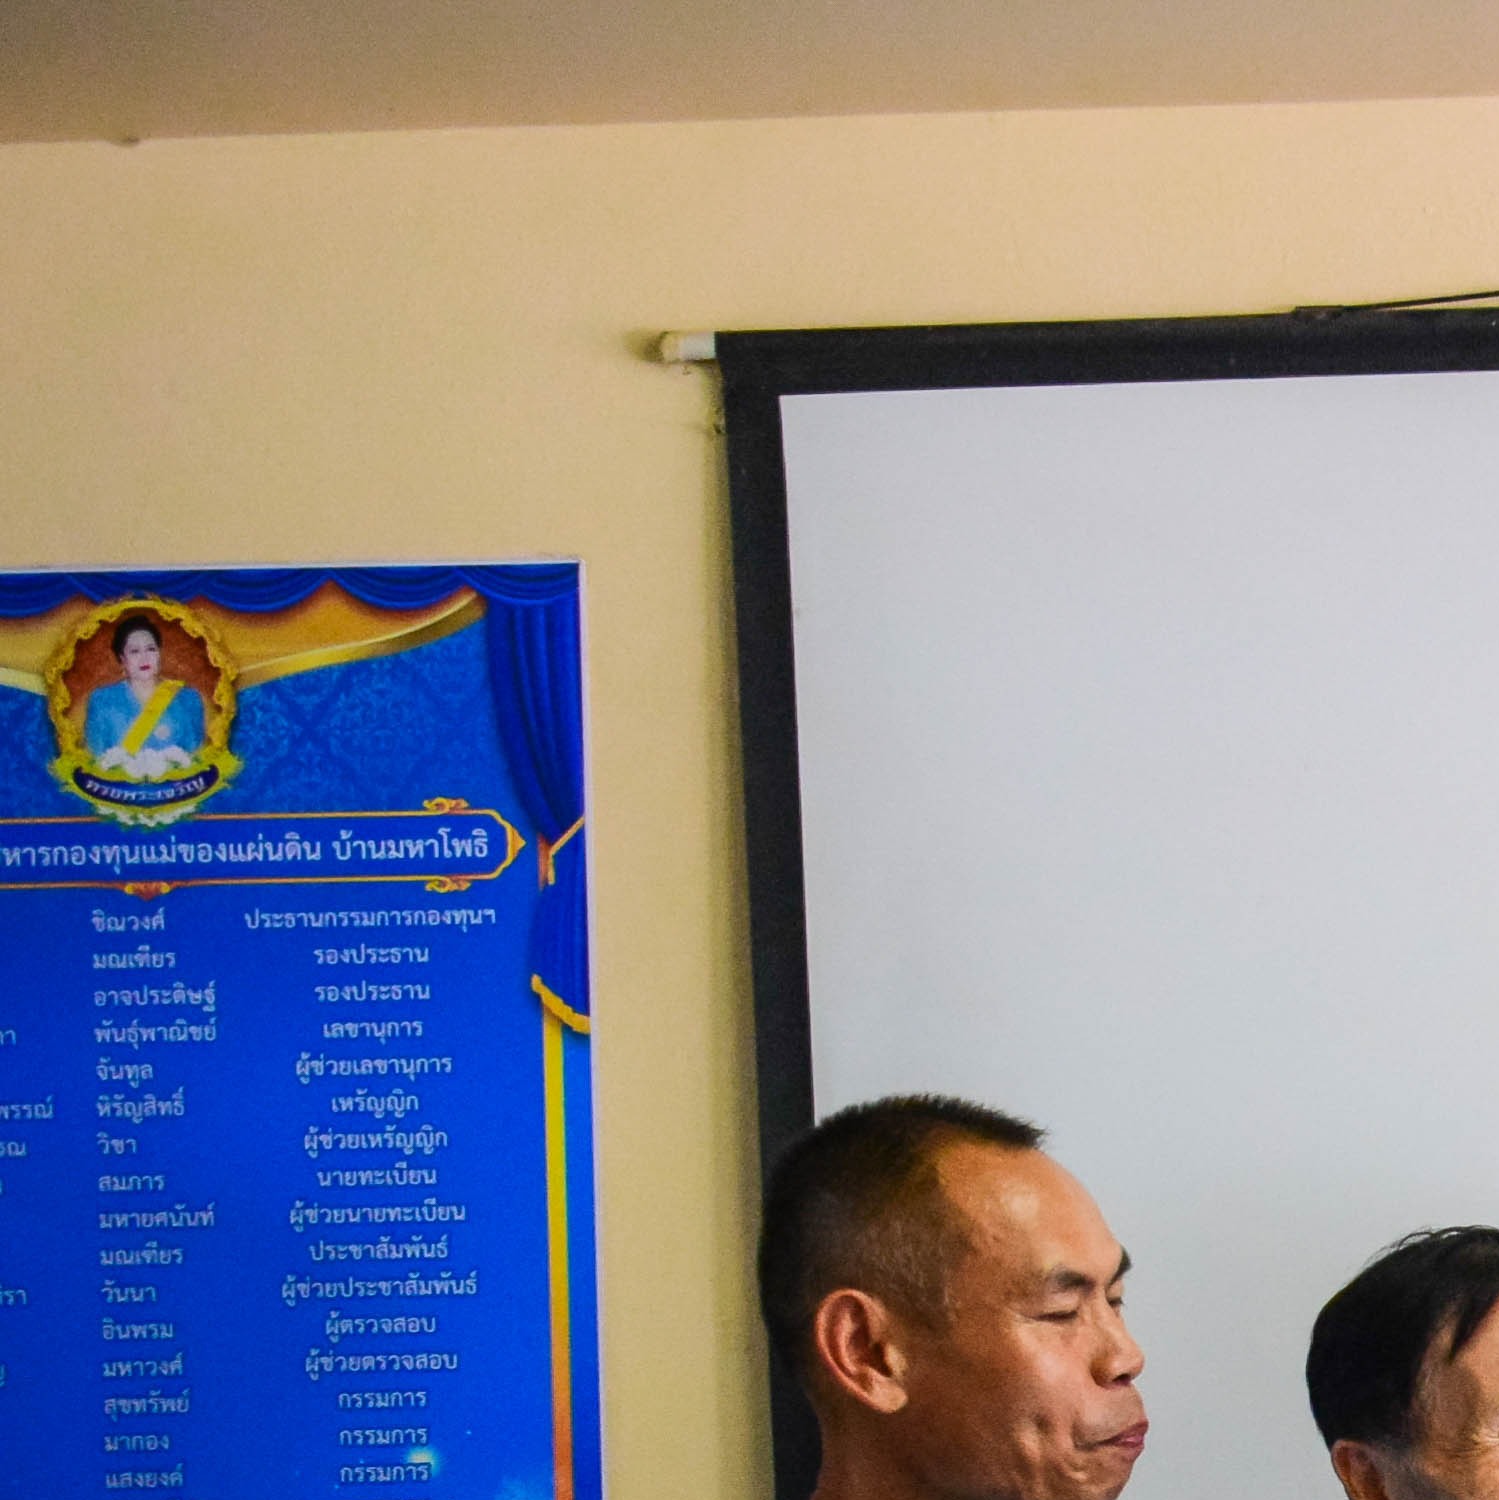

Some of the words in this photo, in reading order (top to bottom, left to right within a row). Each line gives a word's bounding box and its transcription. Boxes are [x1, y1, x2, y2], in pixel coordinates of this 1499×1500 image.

[332, 828, 488, 860] บ้านมหาโพธิ
[244, 908, 495, 933] ประธานกรรมการกองทุนฯ
[313, 943, 429, 964] รองประธาน
[314, 980, 430, 1001] รองประธาน
[323, 1020, 423, 1045] เลขานุการ
[295, 1052, 452, 1084] ผู้ช่วยเลขานุการ
[332, 1088, 419, 1119] เหรัญญิก
[304, 1124, 448, 1158] ผู้ช่วยเหรัญญิก
[317, 1161, 437, 1186] นายทะเบียน
[290, 1198, 466, 1232] ผู้ช่วยนายทะเบียน
[309, 1234, 448, 1261] ประชาสัมพันธ์
[281, 1270, 477, 1307] ผู้ช่วยประชาสัมพันธ์
[325, 1311, 436, 1343] ผู้ตรวจสอบ
[305, 1348, 458, 1381] ผู้ช่วยตรวจสอบ
[338, 1391, 427, 1409] กรรมการ
[339, 1428, 428, 1446] กรรมการ
[340, 1465, 429, 1483] กรรมการ
